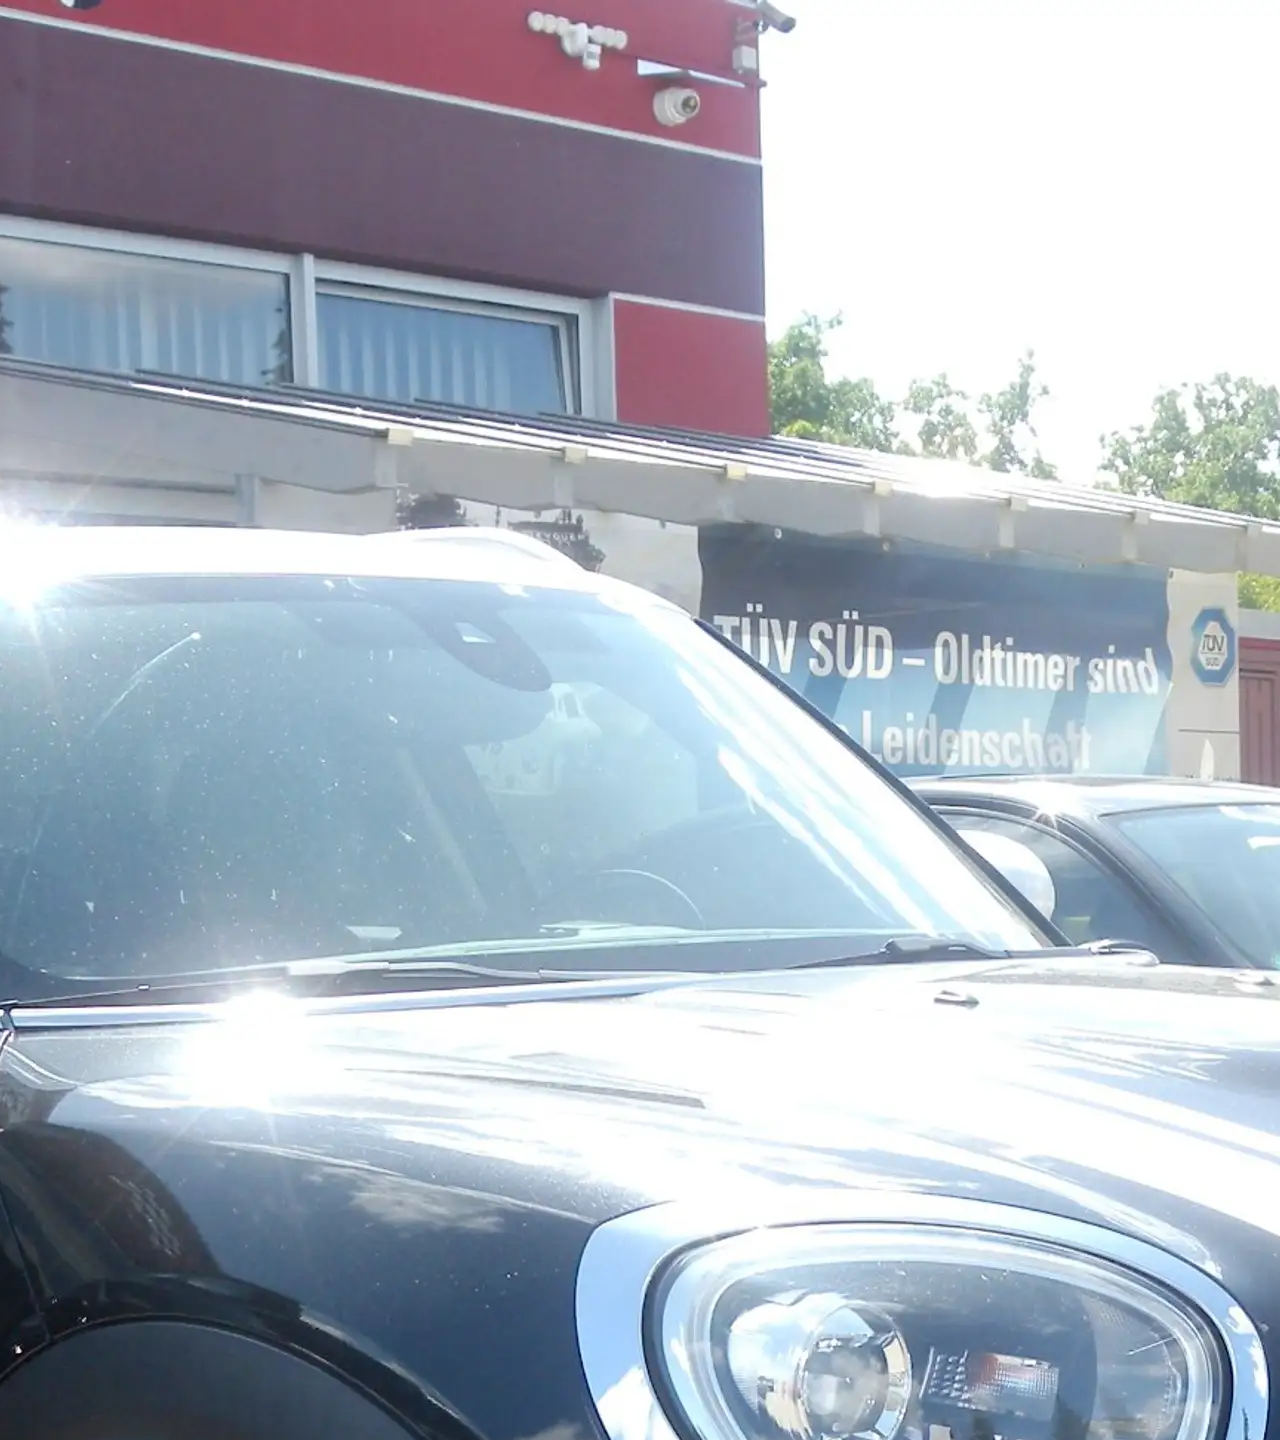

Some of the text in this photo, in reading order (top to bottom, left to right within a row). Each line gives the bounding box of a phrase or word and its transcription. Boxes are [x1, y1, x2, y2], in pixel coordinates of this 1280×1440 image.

[713, 603, 797, 674] TÜV
[809, 610, 893, 679] SÜD
[934, 631, 1080, 691] Oldtimer
[1087, 645, 1159, 694] sind
